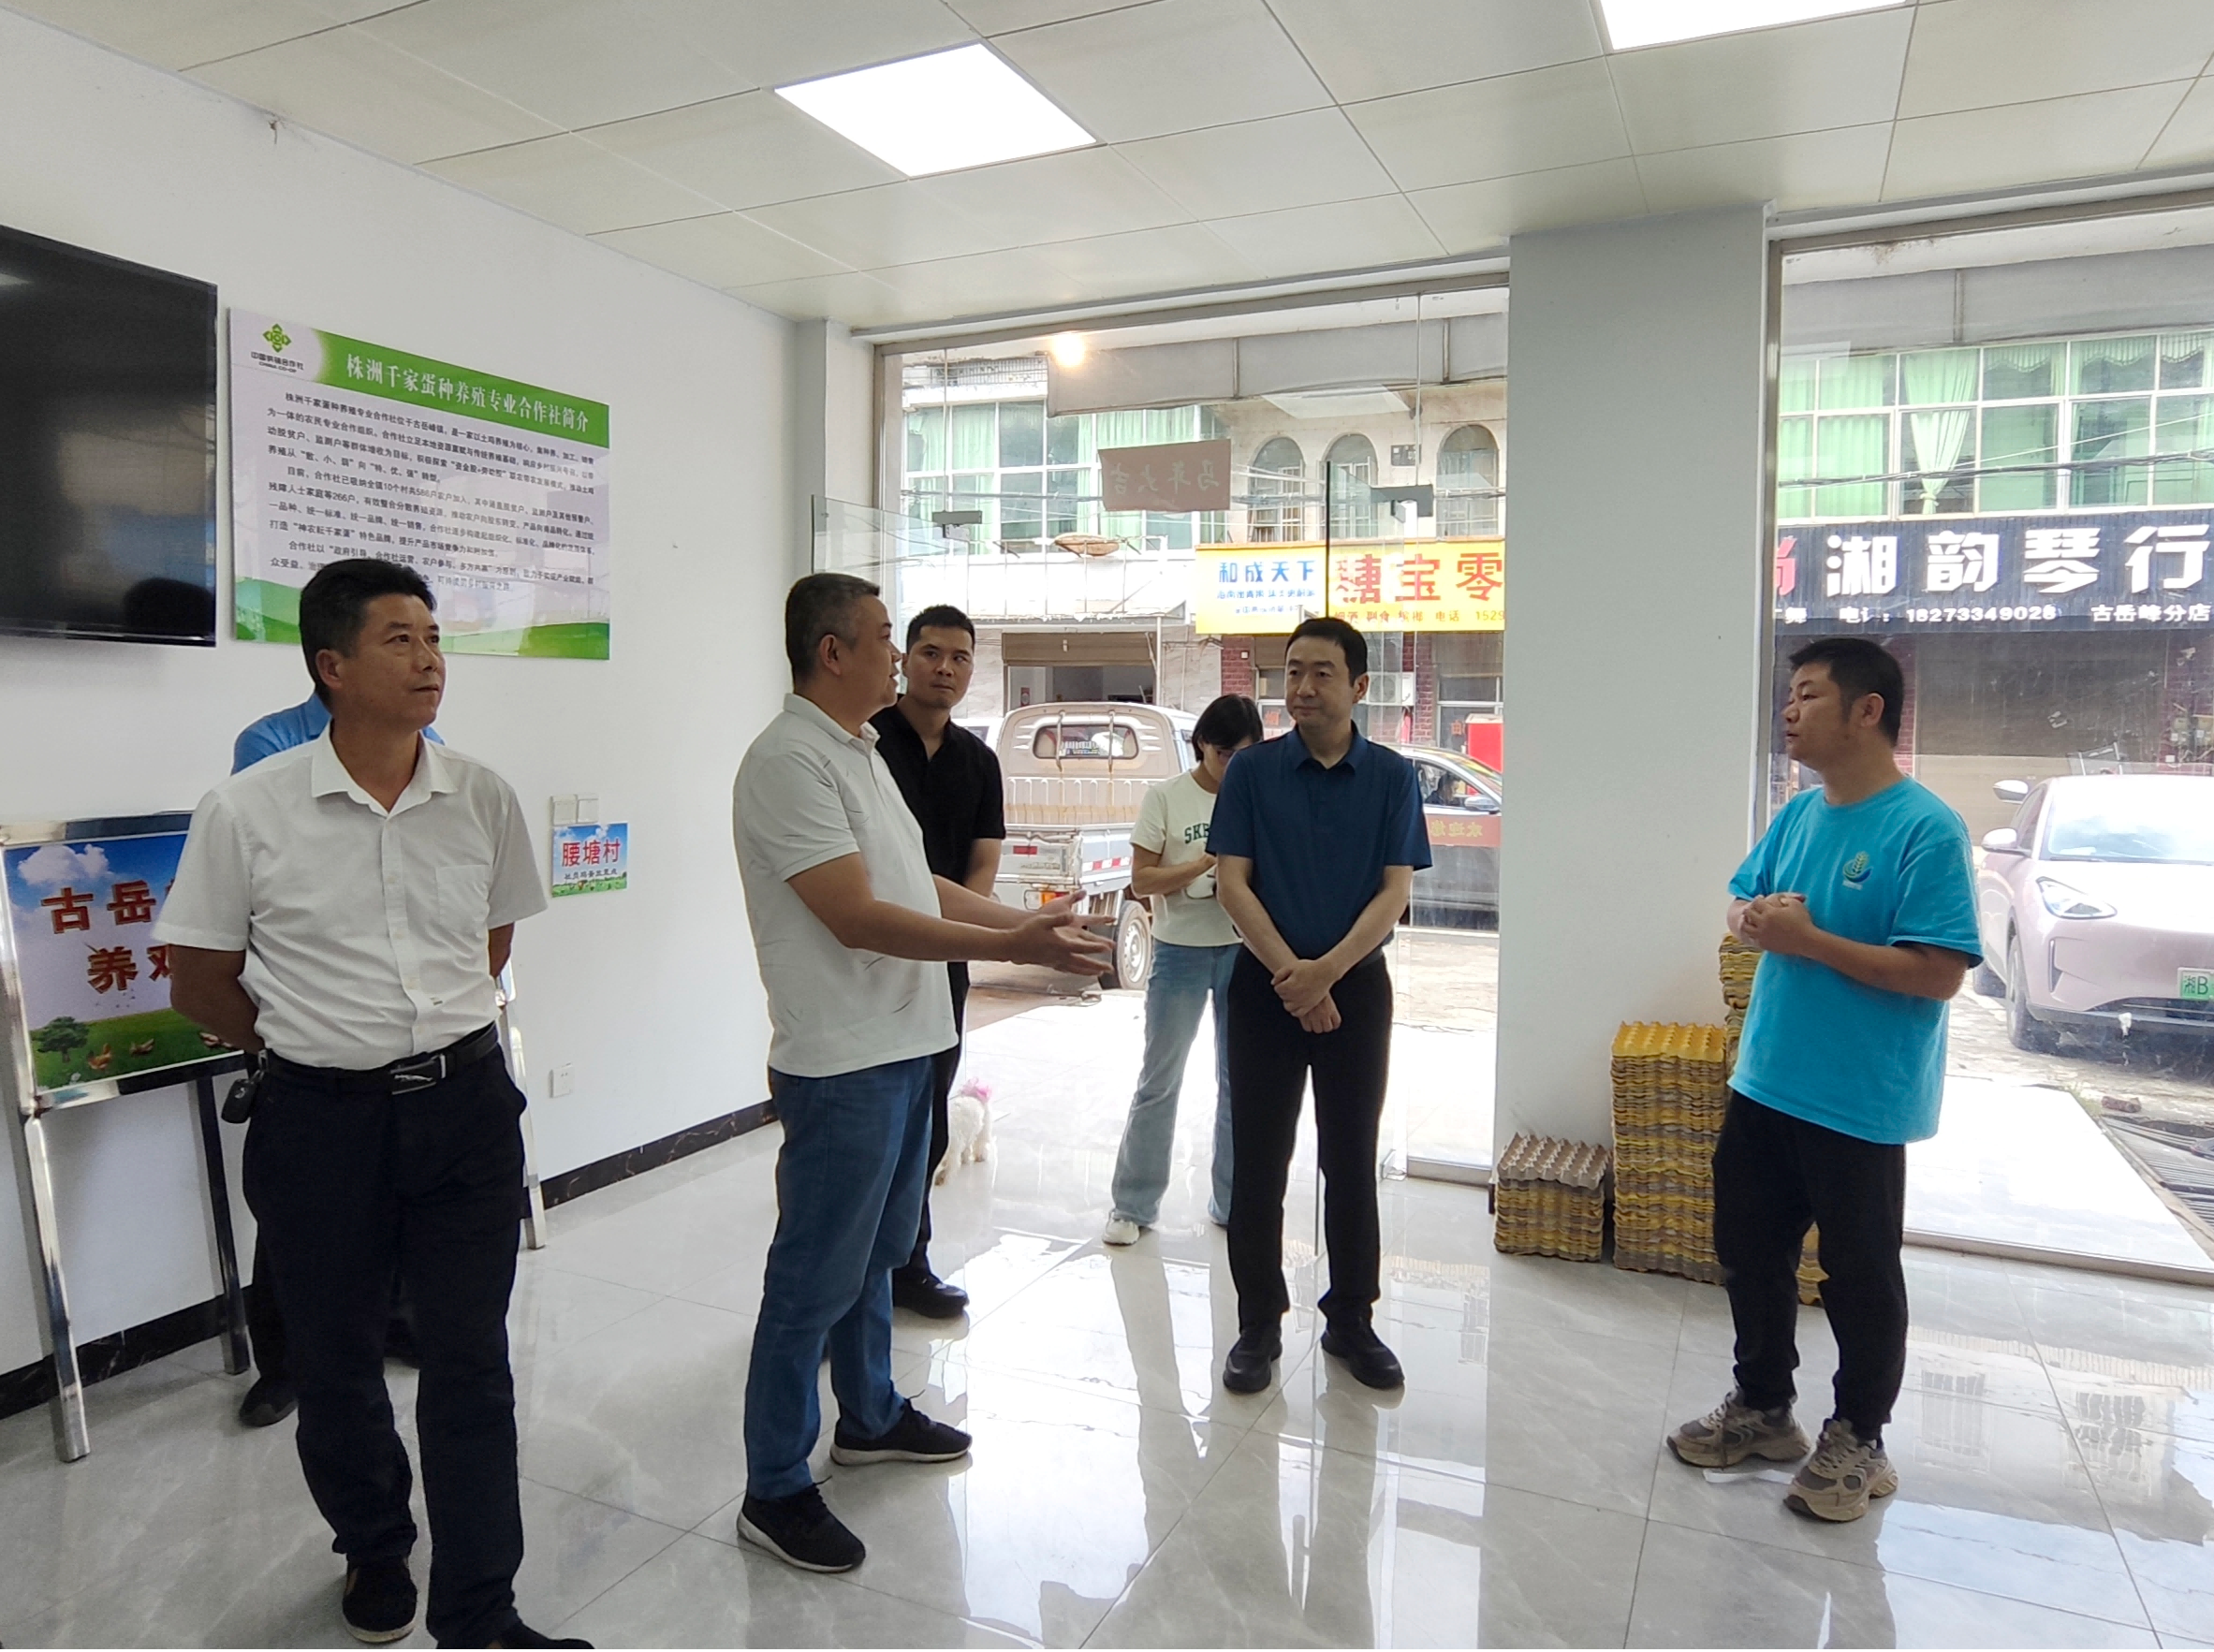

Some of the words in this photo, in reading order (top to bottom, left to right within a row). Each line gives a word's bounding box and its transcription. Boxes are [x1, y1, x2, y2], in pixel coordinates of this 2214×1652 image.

[345, 352, 588, 433] 株洲千家蛋种养殖专业合作社简介
[1219, 560, 1316, 583] 和成天下
[1825, 523, 2210, 597] 湘韵琴行
[1435, 609, 1460, 622] 电话
[2091, 604, 2211, 623] 古岳峰分店
[562, 838, 621, 868] 腰塘村
